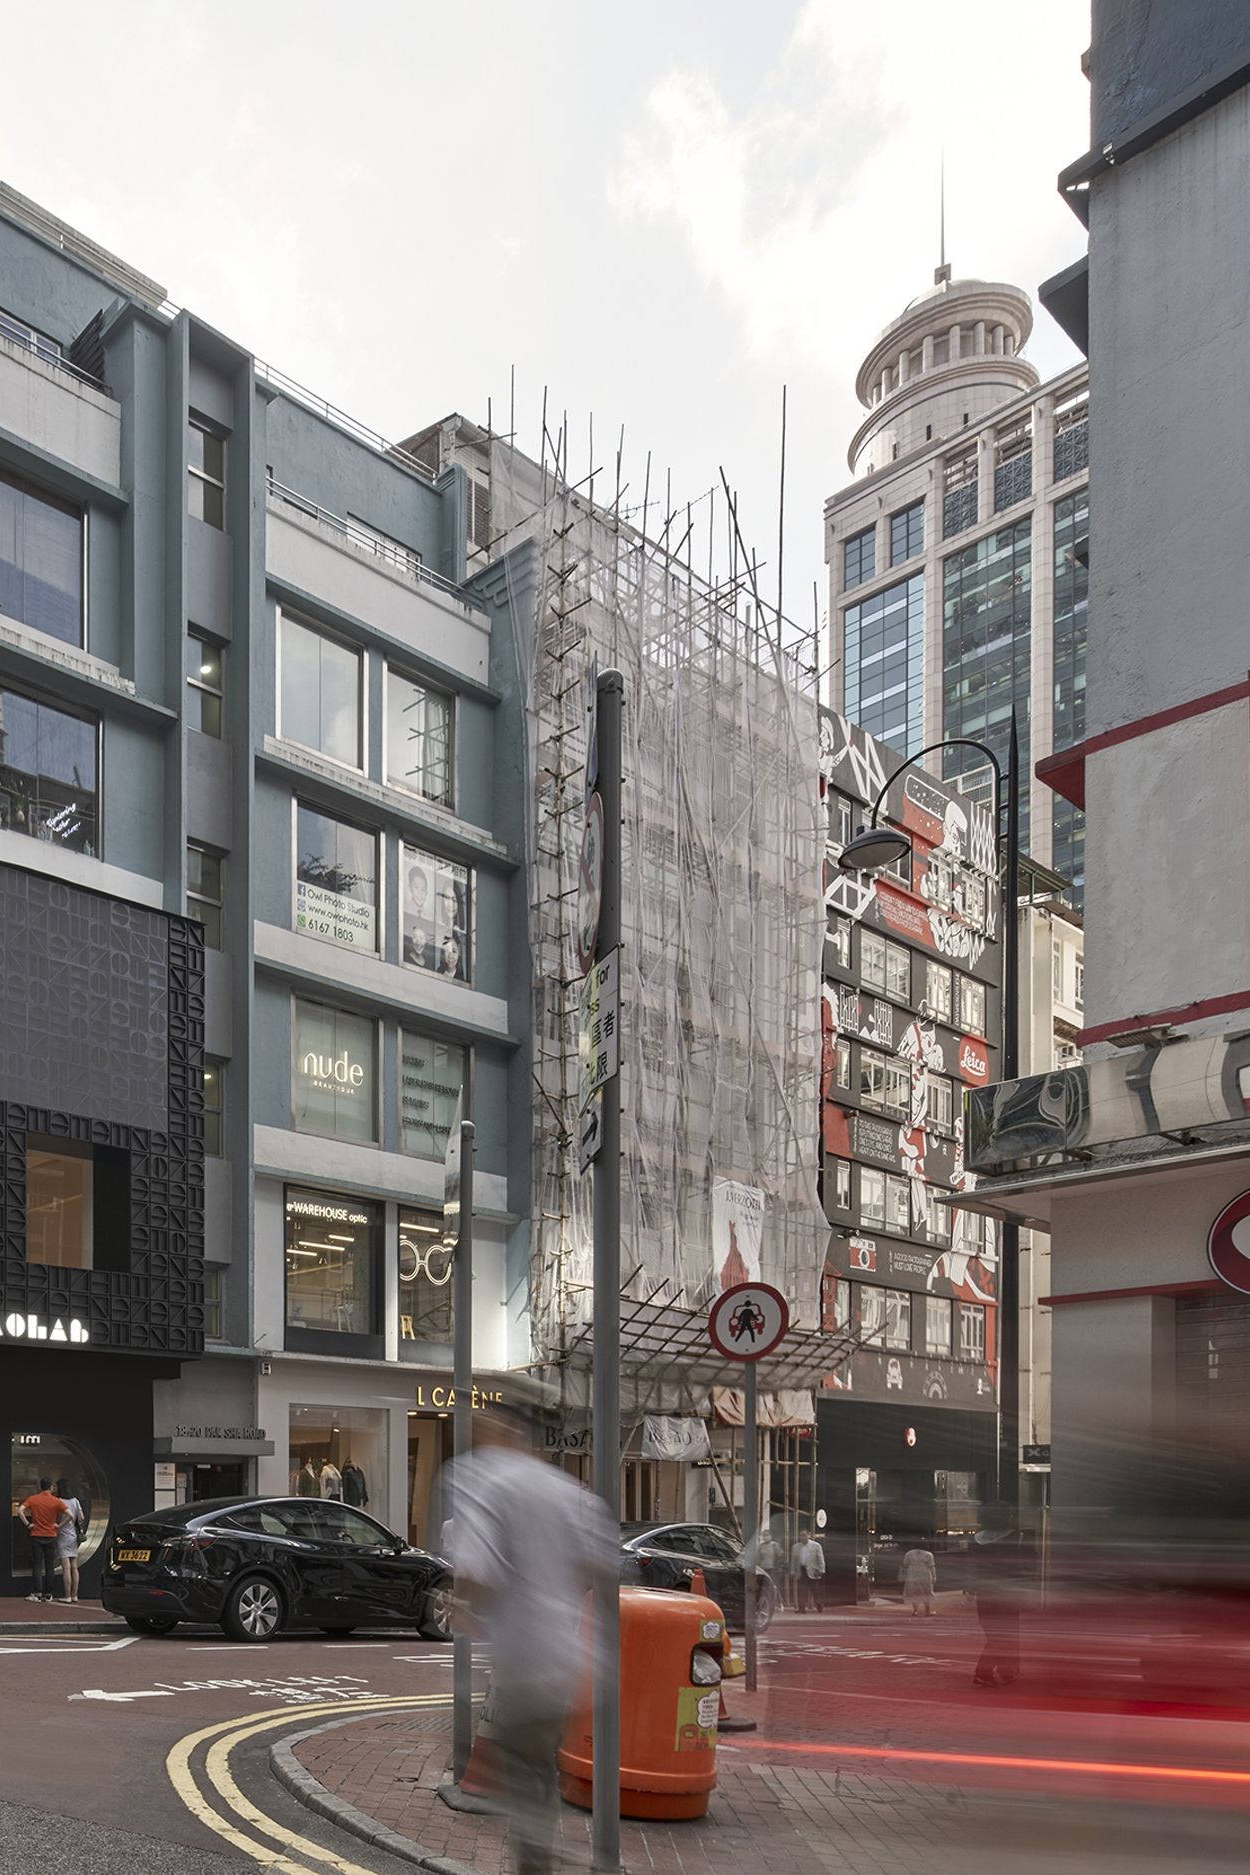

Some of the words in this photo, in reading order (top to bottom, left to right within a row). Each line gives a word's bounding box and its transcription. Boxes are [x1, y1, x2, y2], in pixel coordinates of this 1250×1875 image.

[307, 888, 323, 903] Owl
[324, 894, 346, 910] Photo
[347, 903, 370, 918] Studio
[308, 919, 330, 934] 6167
[333, 926, 354, 942] 1803
[303, 1051, 364, 1087] nude
[960, 1046, 986, 1075] Leica
[348, 1213, 368, 1224] optic
